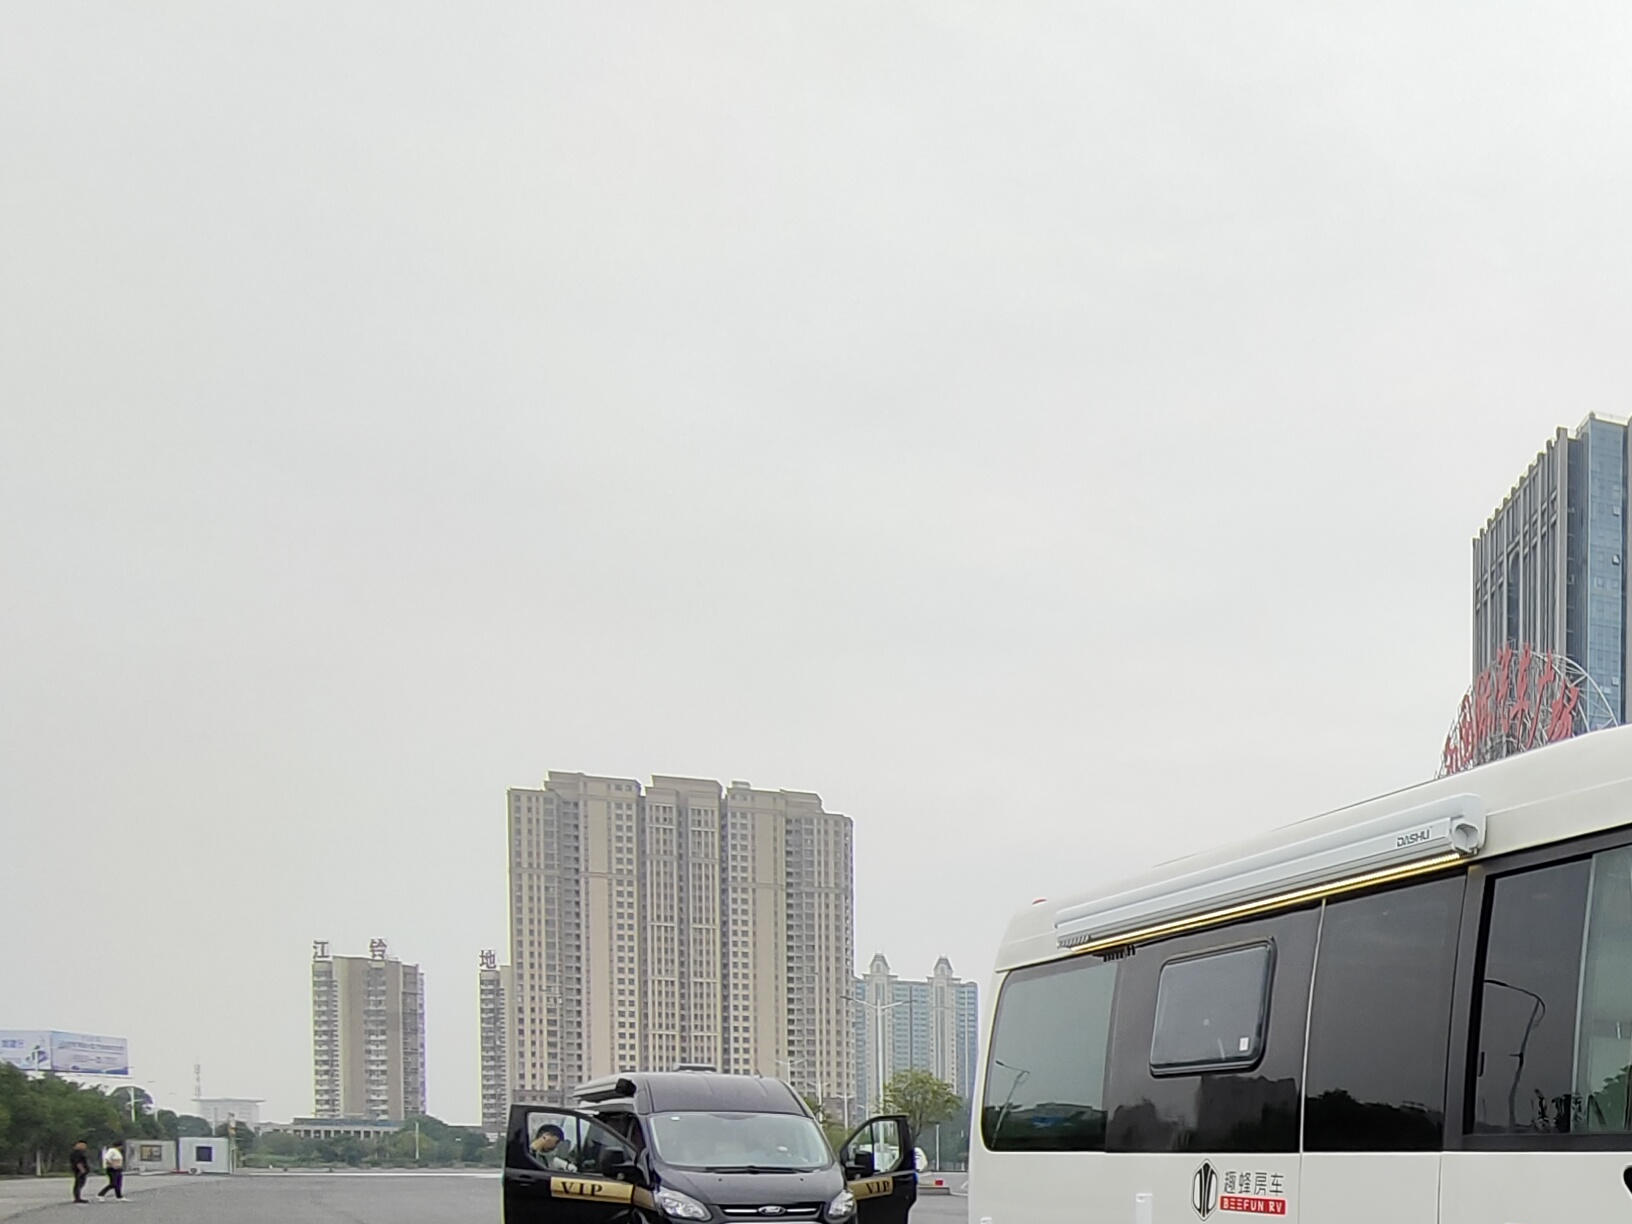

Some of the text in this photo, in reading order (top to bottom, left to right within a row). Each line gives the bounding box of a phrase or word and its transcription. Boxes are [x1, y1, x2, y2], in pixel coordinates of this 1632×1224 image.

[561, 1181, 603, 1197] VIP
[865, 1180, 891, 1195] VIP
[1223, 1198, 1283, 1213] BEEFUN RV
